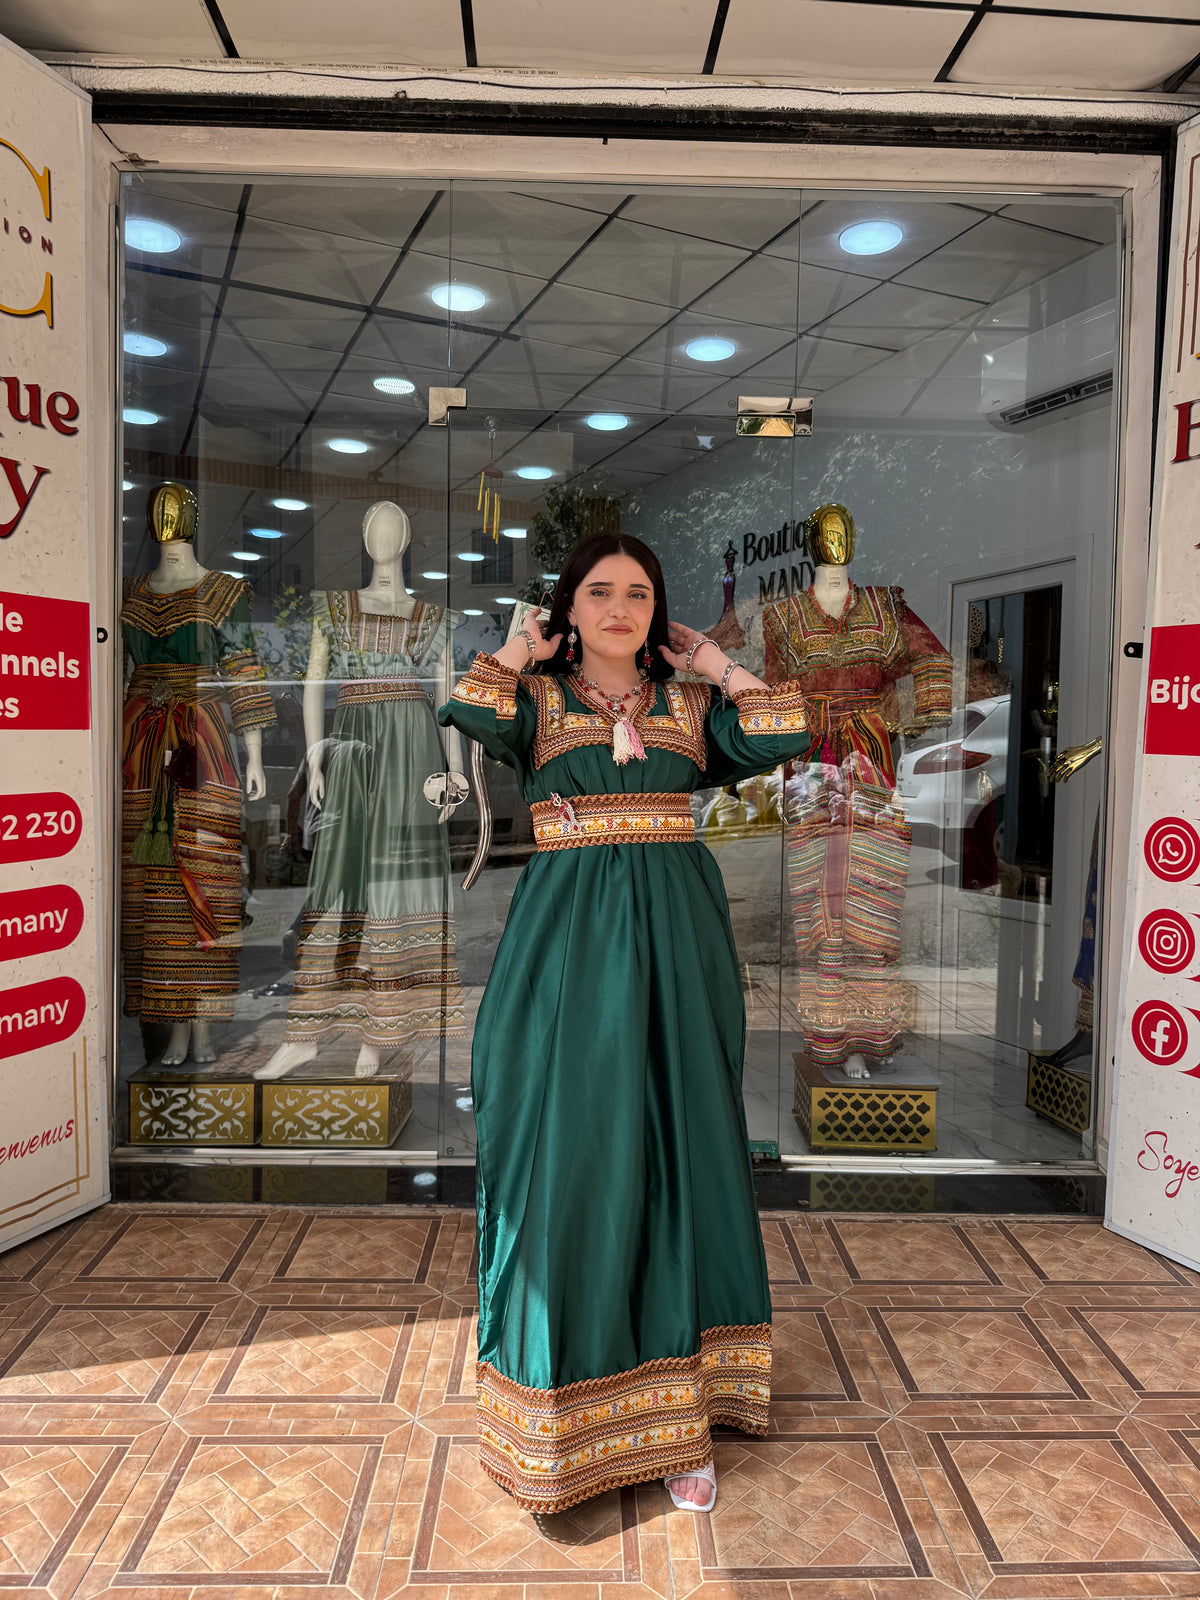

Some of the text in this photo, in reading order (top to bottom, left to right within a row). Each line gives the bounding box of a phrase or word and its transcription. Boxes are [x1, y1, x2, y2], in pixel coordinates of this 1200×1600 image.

[0, 376, 79, 436] ue
[743, 519, 809, 567] Boutiq
[1, 651, 80, 679] nnels
[0, 697, 20, 719] s
[0, 810, 76, 841] 2 230
[0, 908, 69, 938] many
[0, 999, 70, 1034] many
